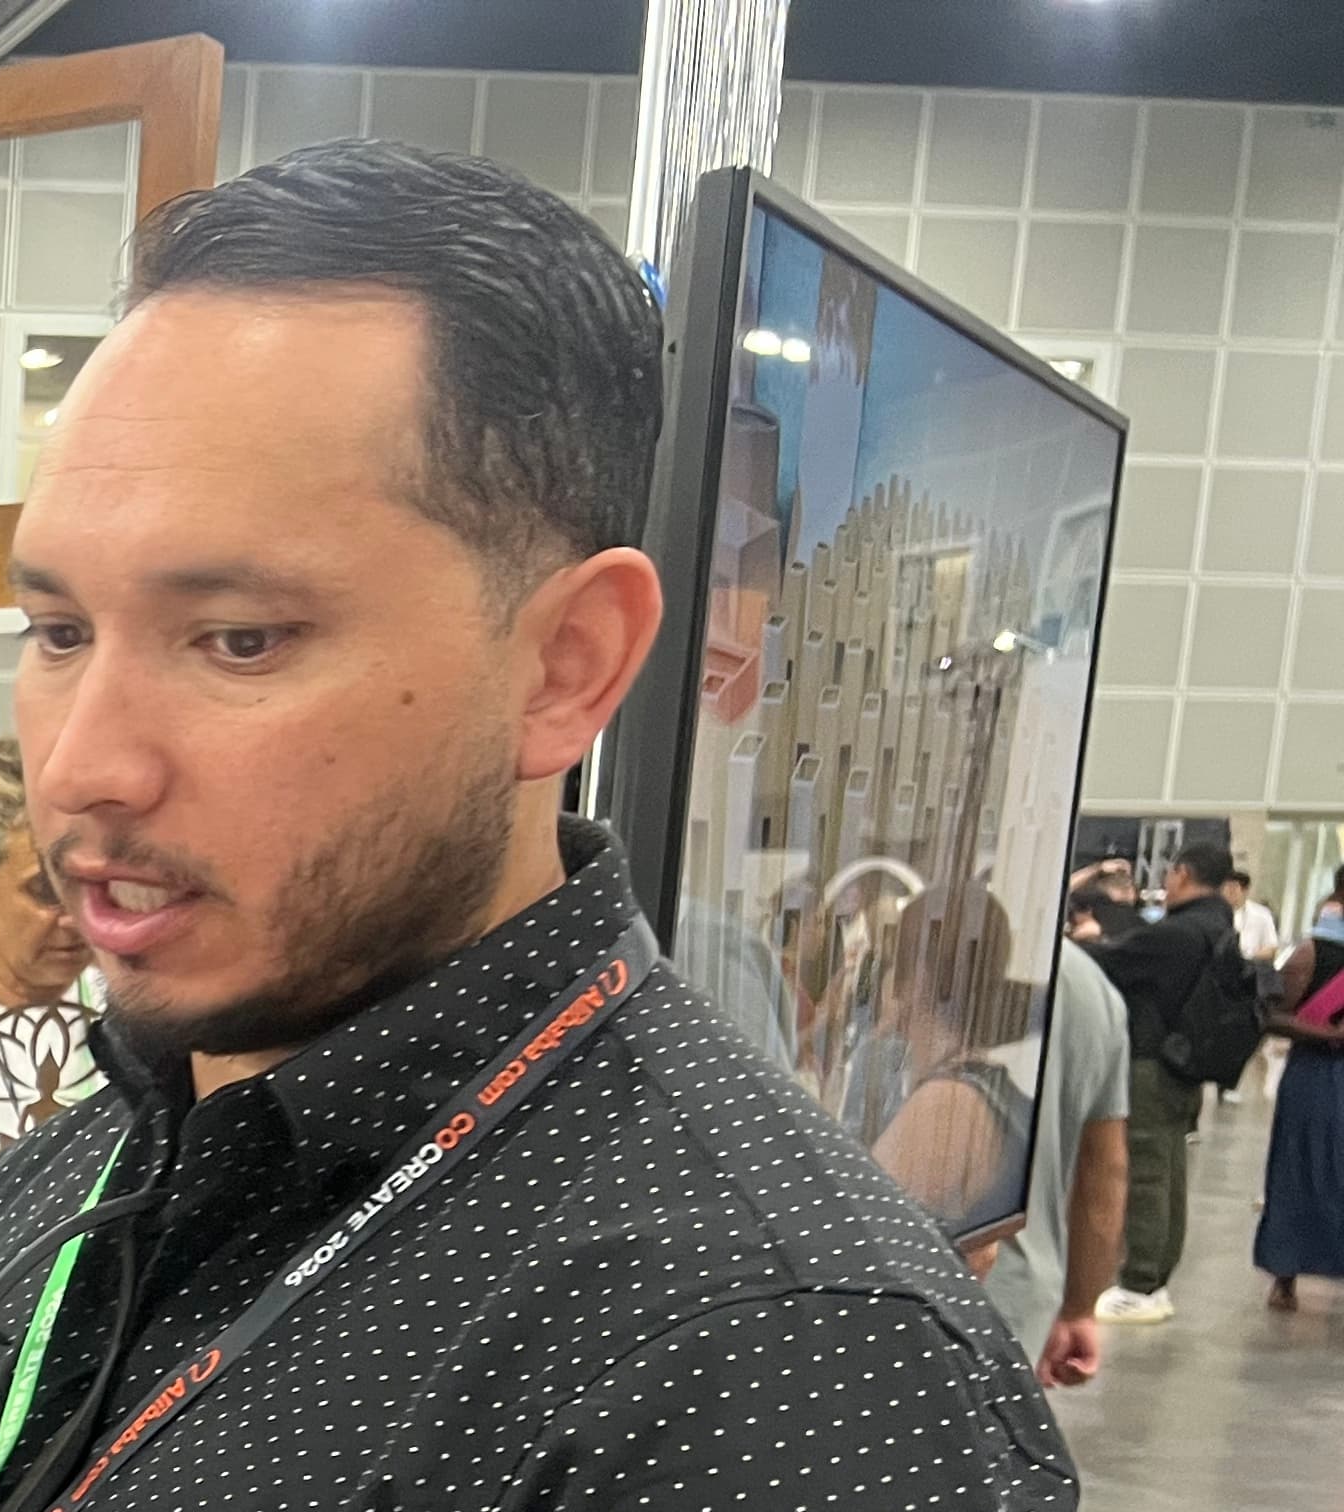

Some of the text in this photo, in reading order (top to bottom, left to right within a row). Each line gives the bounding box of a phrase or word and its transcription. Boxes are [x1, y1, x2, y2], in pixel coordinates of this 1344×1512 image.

[284, 984, 605, 1288] Alibaba.com COCREATE 2026
